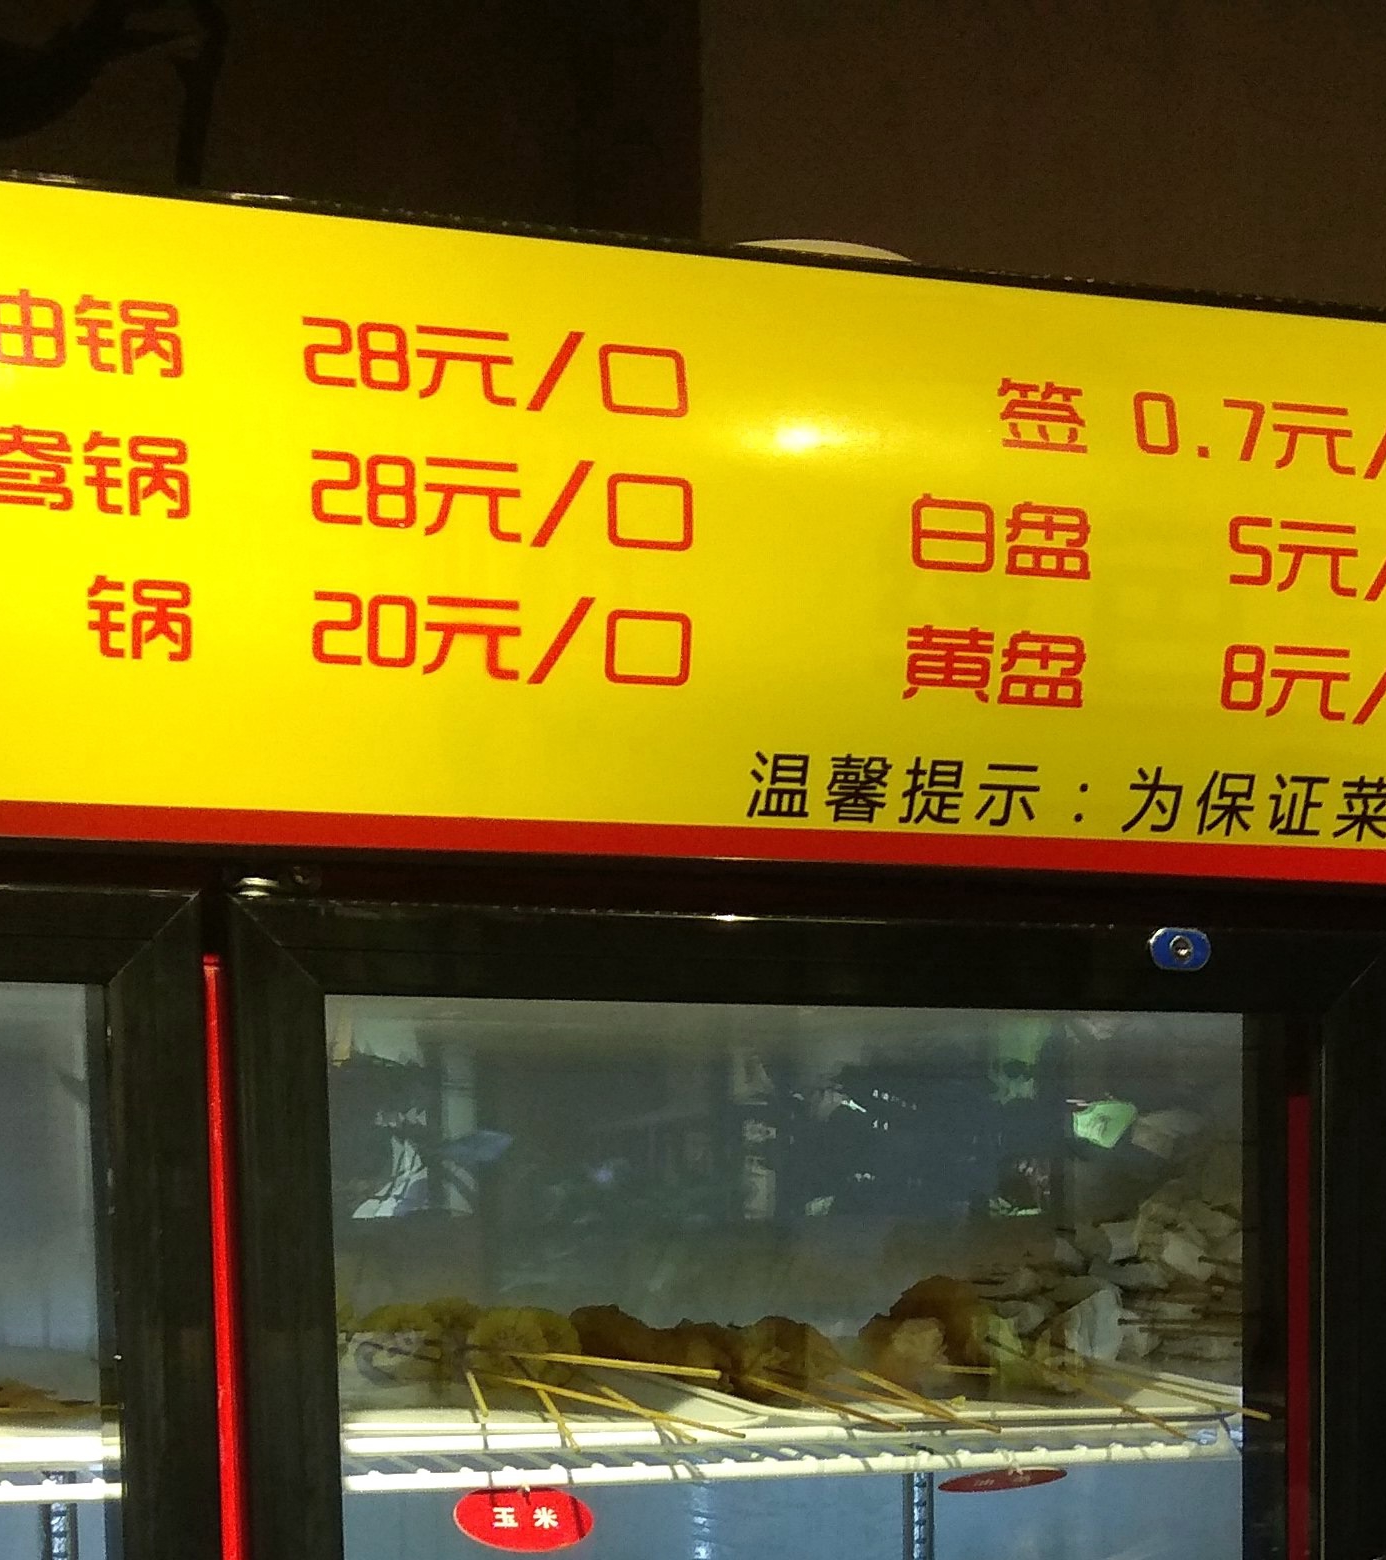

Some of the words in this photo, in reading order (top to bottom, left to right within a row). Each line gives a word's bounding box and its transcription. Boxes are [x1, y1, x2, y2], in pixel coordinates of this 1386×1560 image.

[301, 315, 691, 419] 28元/口
[997, 377, 1088, 454] 签
[310, 449, 695, 552] 28元/口
[911, 493, 1092, 582] 白盘
[310, 591, 693, 687] 20元/口
[902, 624, 1087, 709] 黄盘
[491, 1504, 561, 1531] 玉米
